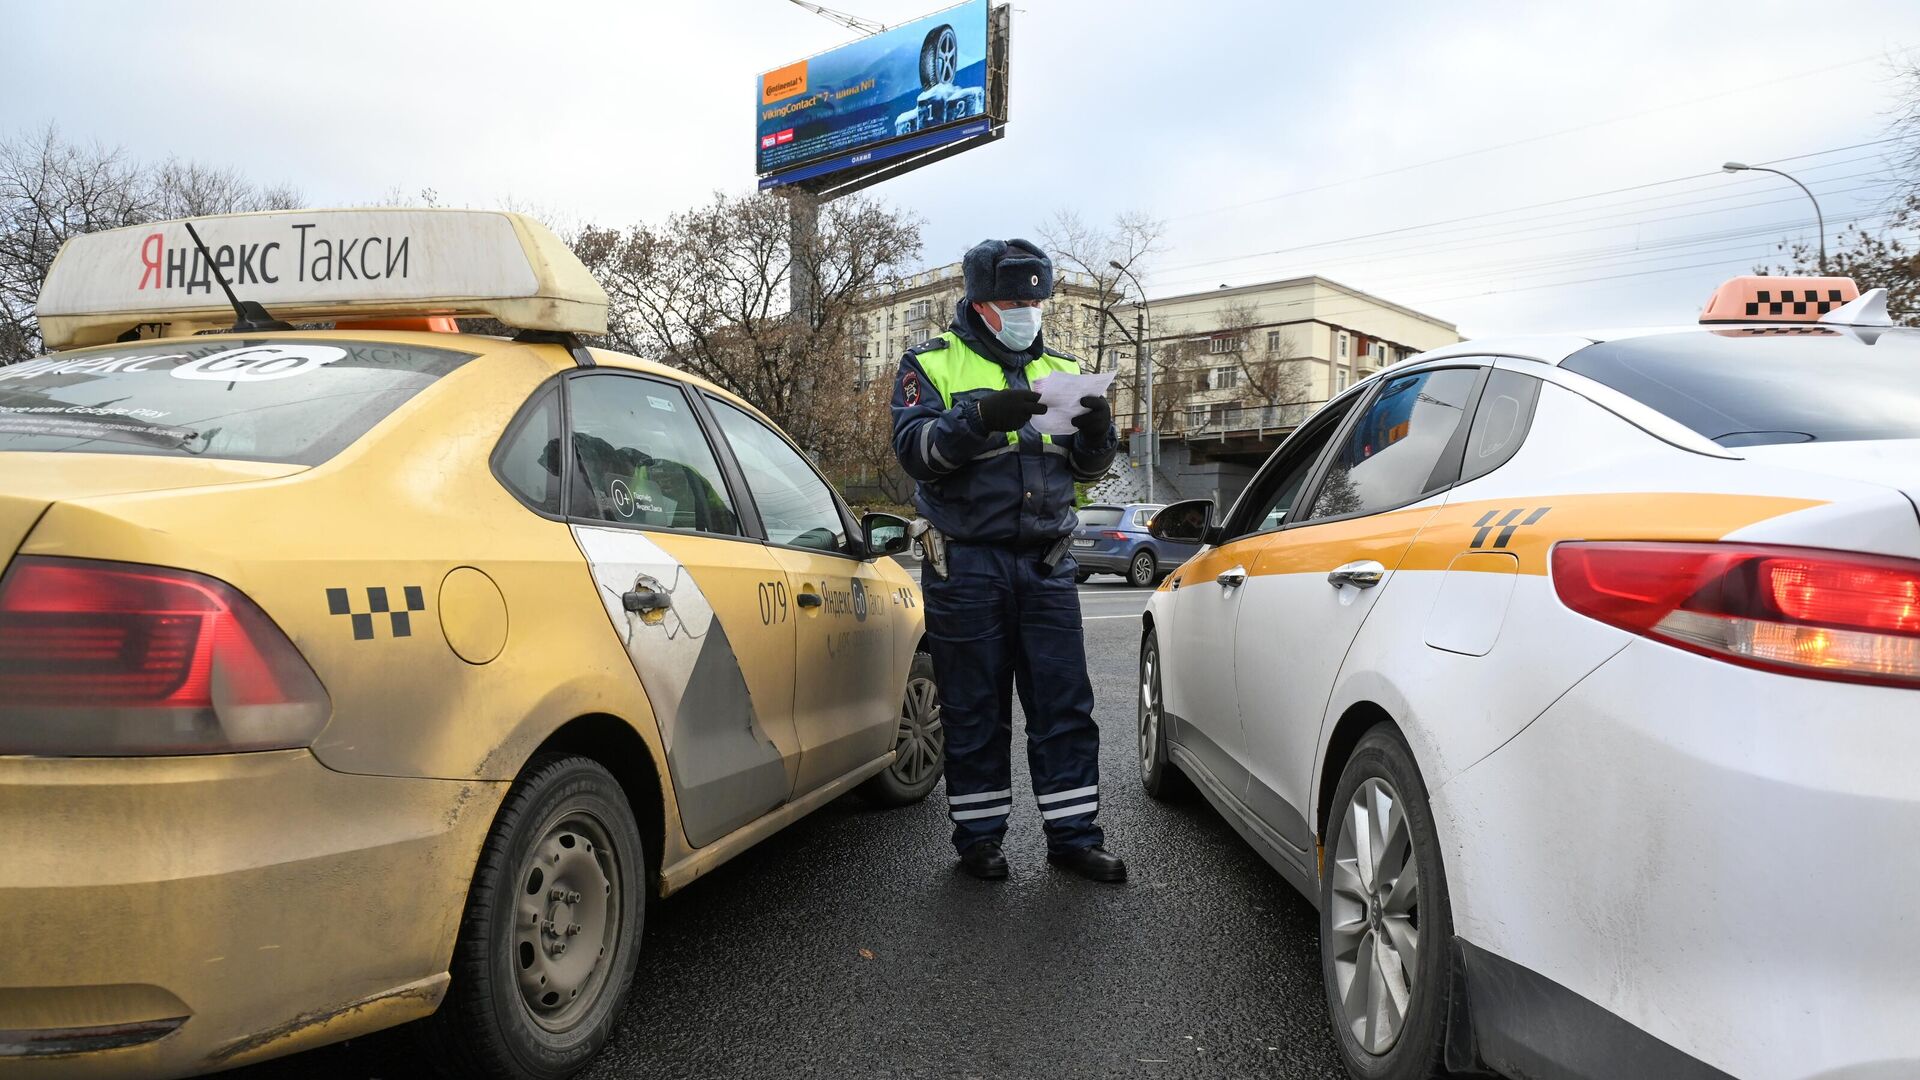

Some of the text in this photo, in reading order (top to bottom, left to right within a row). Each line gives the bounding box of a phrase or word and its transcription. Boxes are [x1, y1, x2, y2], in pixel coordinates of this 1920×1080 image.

[766, 77, 798, 96] Continental
[823, 91, 829, 103] 7
[835, 85, 860, 99] шина
[927, 104, 934, 121] 1
[956, 100, 966, 119] 2
[906, 122, 911, 133] 3
[138, 223, 409, 294] Яндекс Такси
[64, 405, 129, 415] Google
[127, 408, 173, 419] Play
[614, 488, 630, 506] 0+
[758, 581, 787, 626] 079
[821, 581, 886, 619] Яндекс Go Такси
